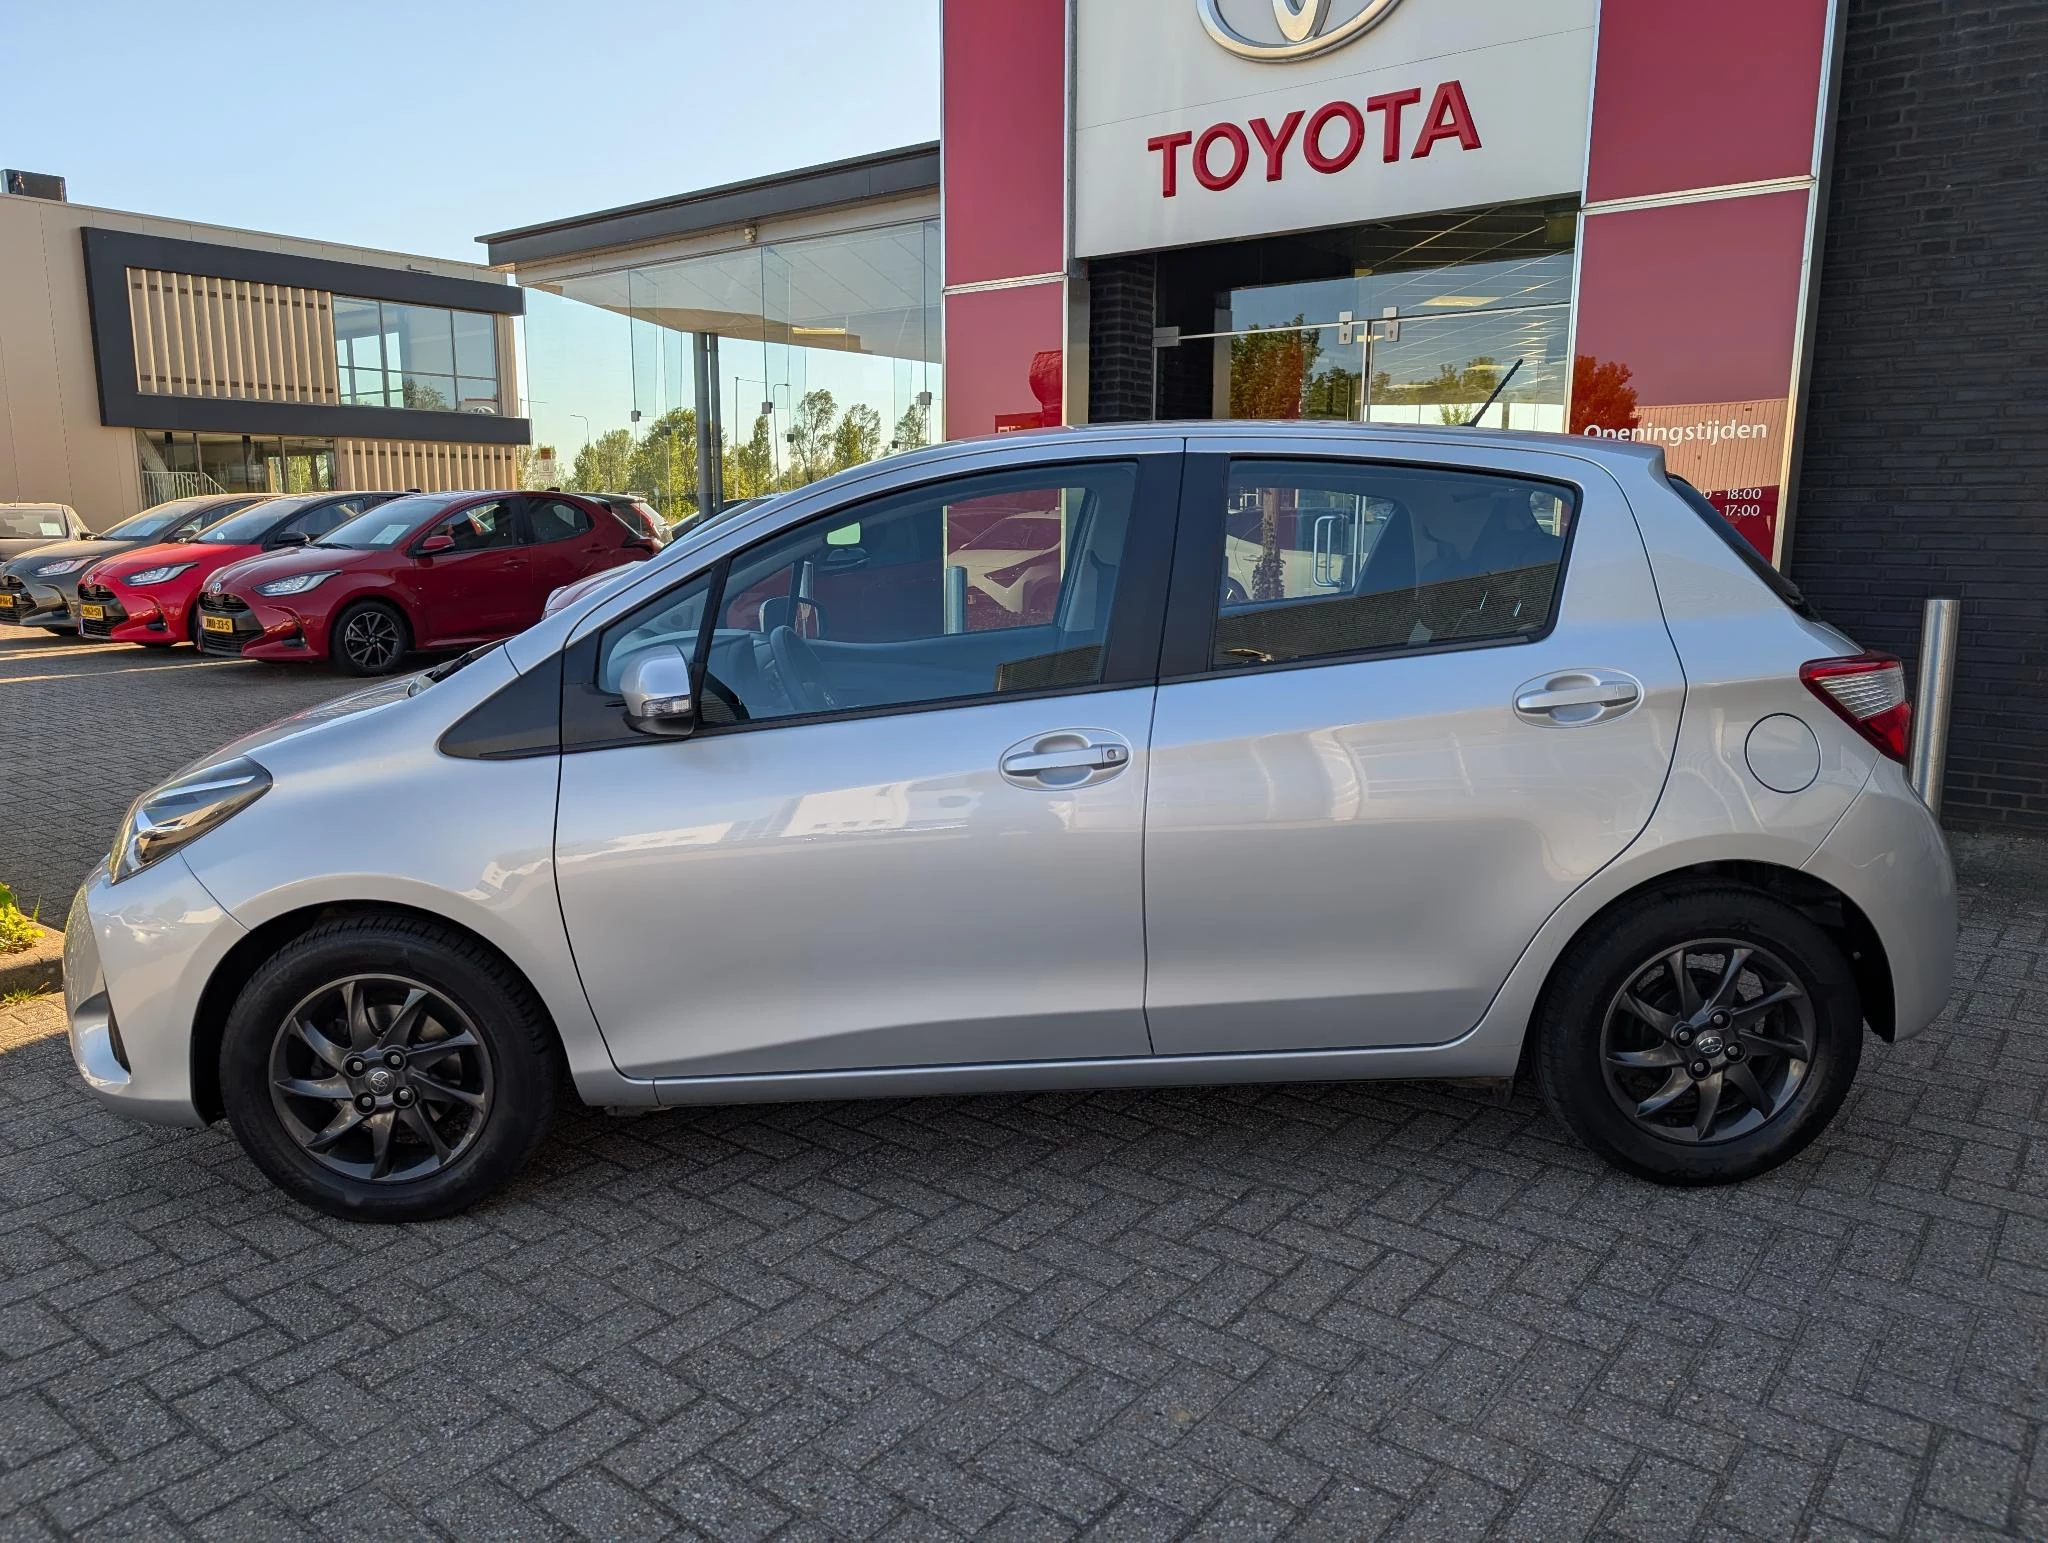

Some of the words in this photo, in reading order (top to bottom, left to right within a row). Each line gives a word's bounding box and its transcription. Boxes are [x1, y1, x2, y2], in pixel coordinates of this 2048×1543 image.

[1147, 80, 1481, 198] TOYOTA
[1727, 488, 1762, 500] 18:00
[1724, 504, 1760, 516] 17:00
